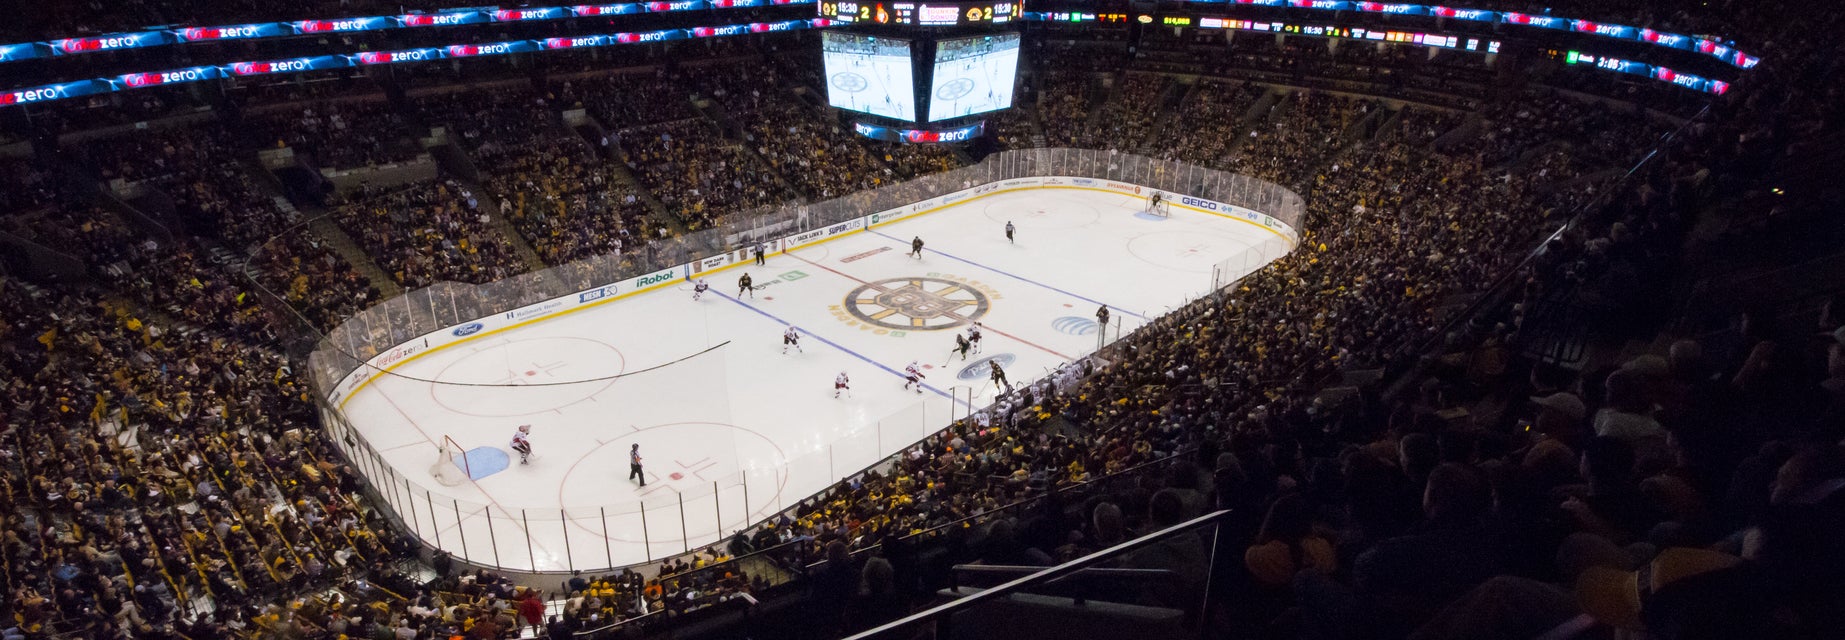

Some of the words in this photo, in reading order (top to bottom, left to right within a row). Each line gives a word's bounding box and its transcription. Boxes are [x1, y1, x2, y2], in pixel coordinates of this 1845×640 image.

[830, 3, 837, 16] 2
[838, 2, 857, 13] 15:30
[861, 6, 870, 19] 2
[983, 7, 992, 20] 2
[14, 88, 56, 103] zero
[938, 130, 966, 141] zero
[1182, 196, 1217, 210] GEICO
[828, 220, 861, 235] SUPERCUTS
[636, 270, 675, 288] iRobot
